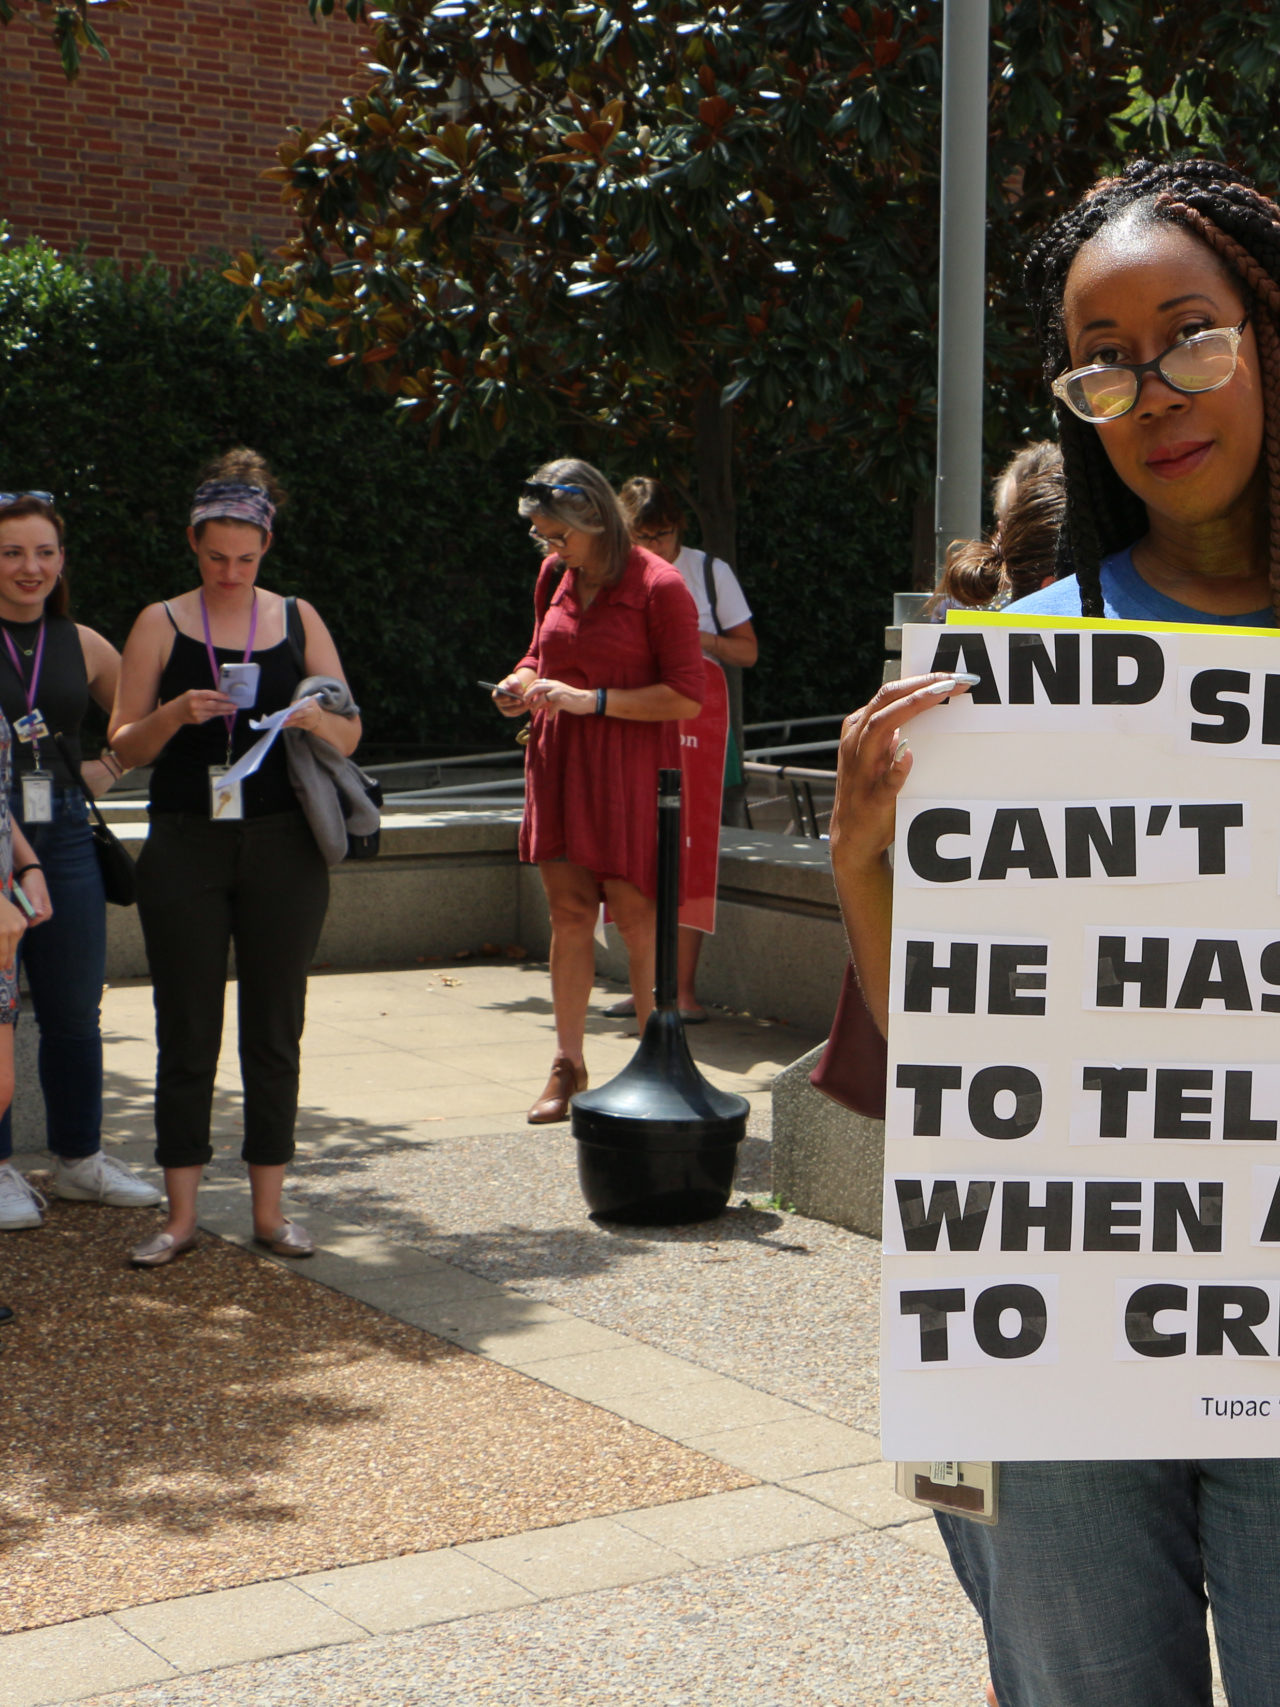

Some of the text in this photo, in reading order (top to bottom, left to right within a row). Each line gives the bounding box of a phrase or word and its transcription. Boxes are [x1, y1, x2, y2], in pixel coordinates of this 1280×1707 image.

[931, 634, 1164, 704] AND
[908, 804, 1243, 882] CAN'T
[904, 941, 1047, 1015] HE
[896, 1064, 1042, 1140] TO
[895, 1180, 1223, 1252] WHEN
[901, 1284, 1046, 1361] TO
[1202, 1398, 1270, 1419] Tupac
